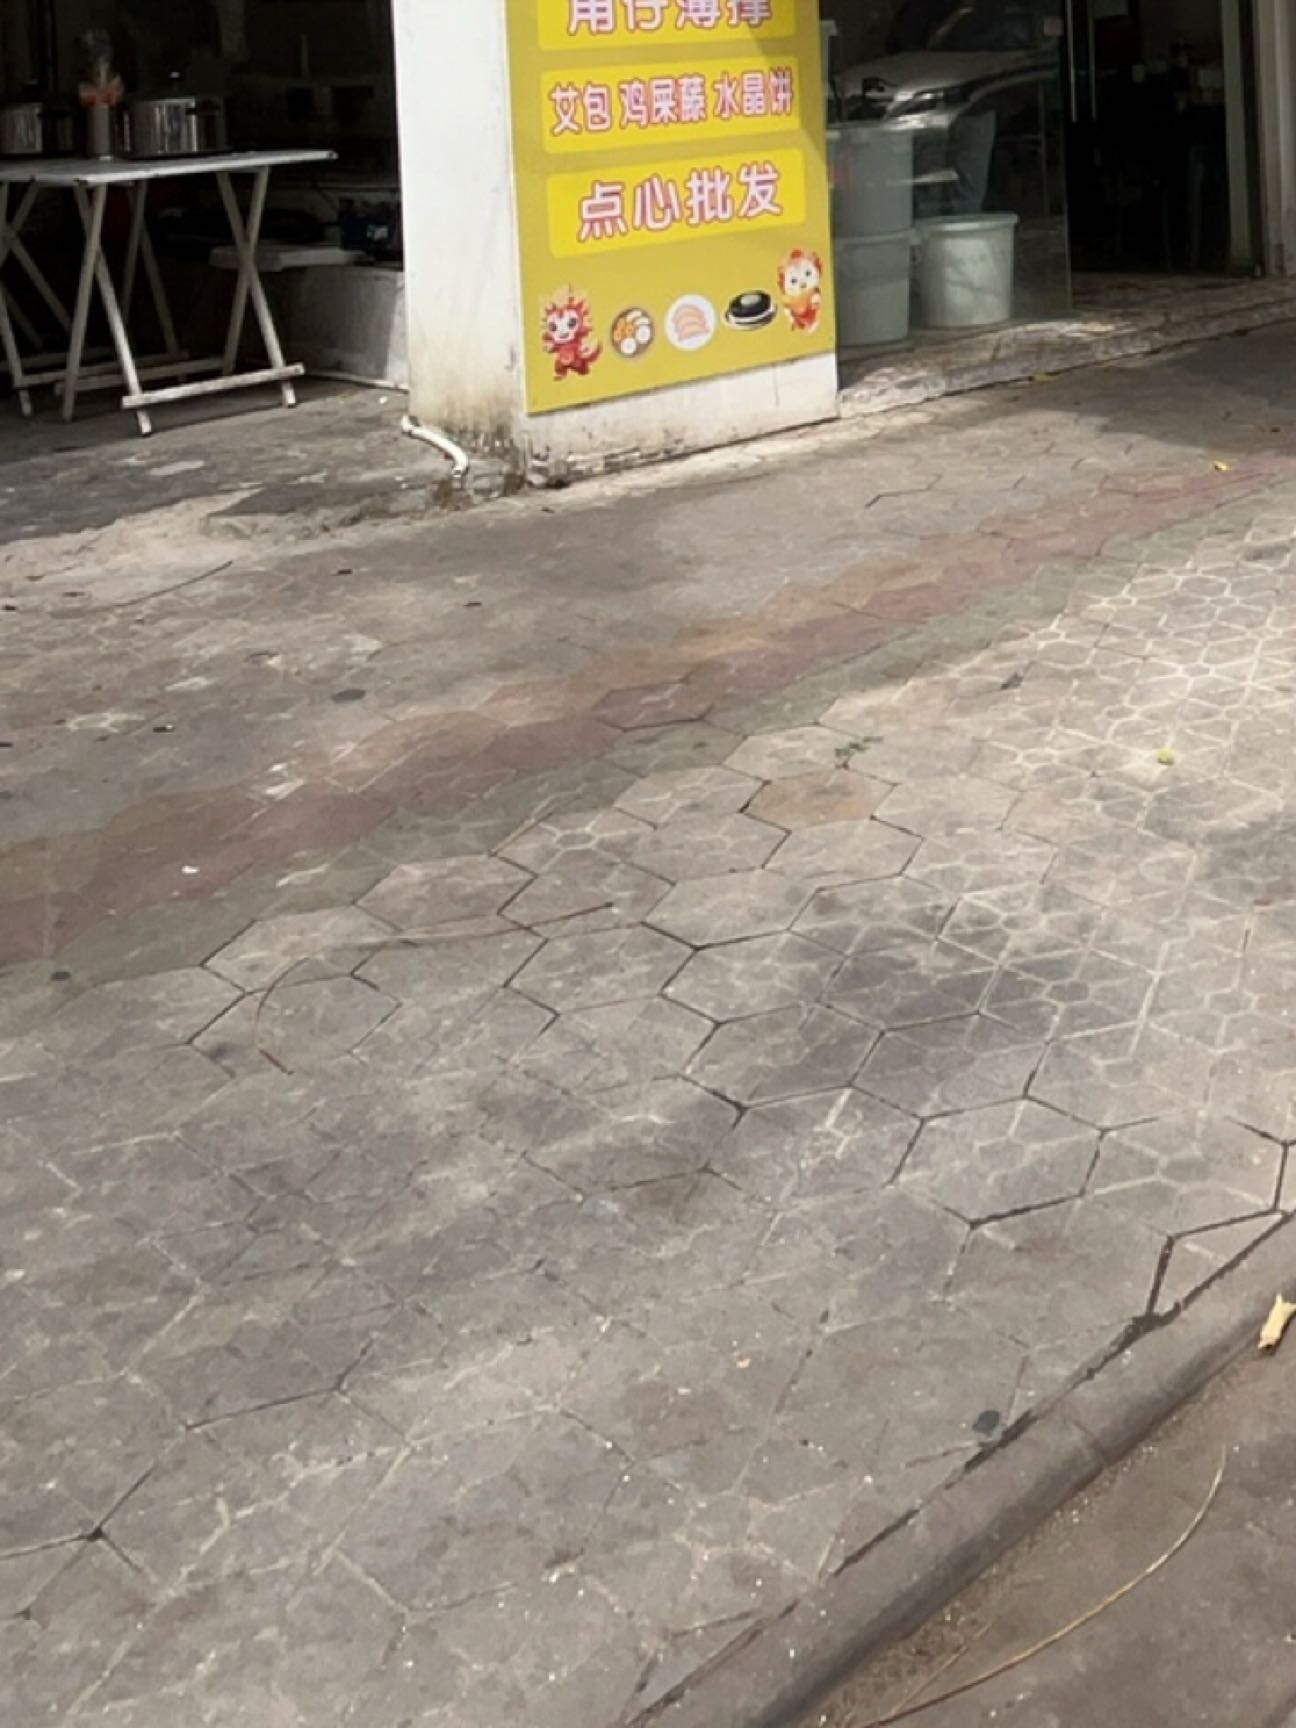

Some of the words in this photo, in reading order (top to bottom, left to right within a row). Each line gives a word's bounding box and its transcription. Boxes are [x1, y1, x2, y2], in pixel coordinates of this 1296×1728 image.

[550, 81, 613, 138] 艾包
[713, 65, 795, 120] 水晶饼
[576, 160, 784, 244] 点心批发
